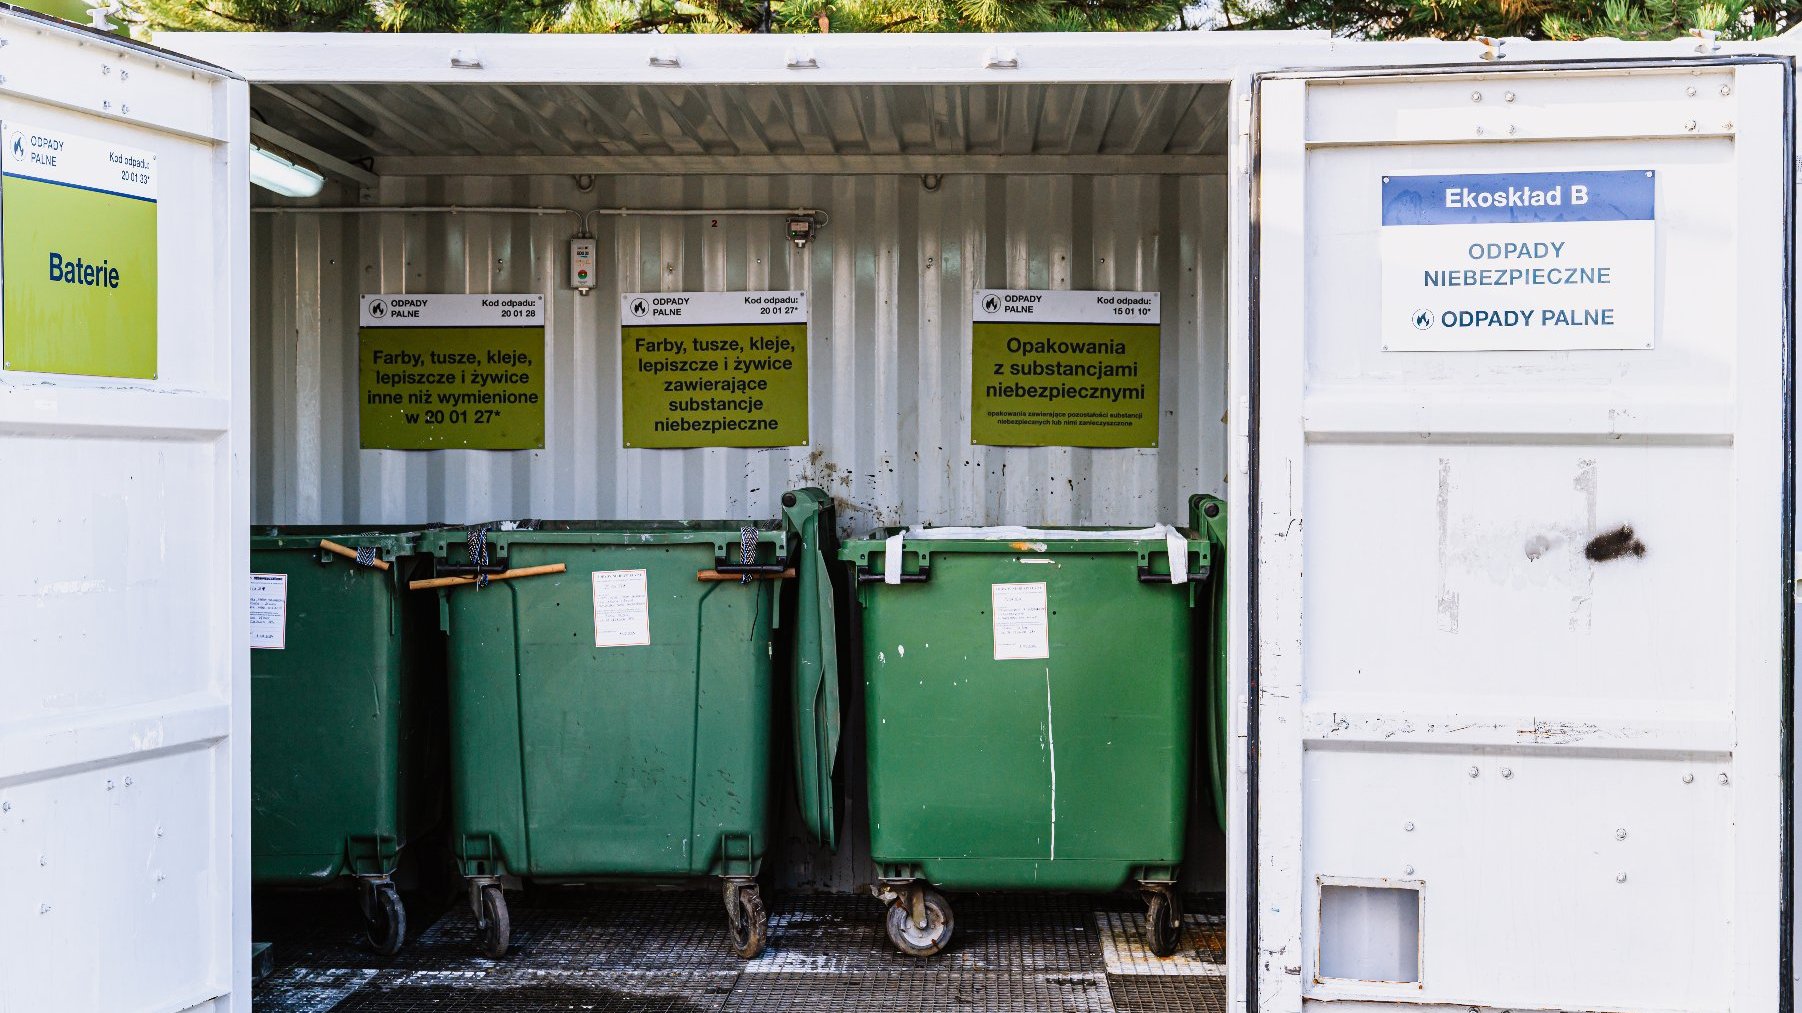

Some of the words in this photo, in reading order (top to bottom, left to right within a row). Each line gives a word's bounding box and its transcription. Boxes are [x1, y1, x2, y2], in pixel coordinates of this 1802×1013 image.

[30, 135, 64, 152] ODPADY
[30, 152, 57, 167] PALNE
[110, 151, 122, 164] Kod
[122, 170, 130, 180] 20
[130, 172, 138, 182] 01
[1445, 186, 1561, 208] Ekoskład
[1570, 184, 1589, 205] B
[712, 220, 718, 228] 2
[1468, 242, 1566, 260] ODPADY
[50, 252, 120, 289] Baterie
[1424, 267, 1611, 287] NIEBEZPIECZNE
[482, 299, 499, 307] Kod
[501, 299, 536, 308] odpadu:
[652, 298, 690, 306] ODPADY
[744, 296, 762, 304] Kod
[764, 296, 798, 306] odpadu:
[1004, 294, 1042, 303] ODPADY
[1096, 296, 1114, 304] Kod
[1116, 297, 1152, 306] odpadu:
[390, 310, 420, 318] PALNE
[501, 310, 512, 318] 20
[514, 310, 523, 318] 01
[526, 310, 536, 318] 28
[652, 308, 682, 316] PALNE
[1441, 310, 1534, 328] ODPADY
[1541, 308, 1614, 326] PALNE
[635, 338, 687, 354] Farby,
[692, 338, 744, 353] tusze,
[750, 336, 795, 353] kleje,
[1006, 337, 1126, 357] Opakowania
[373, 350, 424, 367] Farby,
[430, 351, 482, 366] tusze,
[487, 350, 532, 367] kleje,
[638, 358, 718, 375] lepiszcze
[724, 356, 728, 370] i
[734, 356, 792, 373] żywice
[376, 370, 456, 387] lepiszcze
[461, 370, 466, 384] i
[470, 370, 530, 386] żywice
[993, 363, 1004, 375] z
[1010, 360, 1138, 380] substancjami
[664, 377, 768, 394] zawierające
[986, 382, 1145, 402] niebezpiecznymi
[367, 390, 403, 404] inne
[408, 390, 432, 404] niż
[438, 390, 538, 407] wymienione
[668, 396, 764, 413] substancje
[404, 413, 419, 424] w
[424, 410, 444, 424] 20
[449, 410, 467, 424] 01
[654, 416, 778, 433] niebezpieczne
[1110, 412, 1142, 420] substancji
